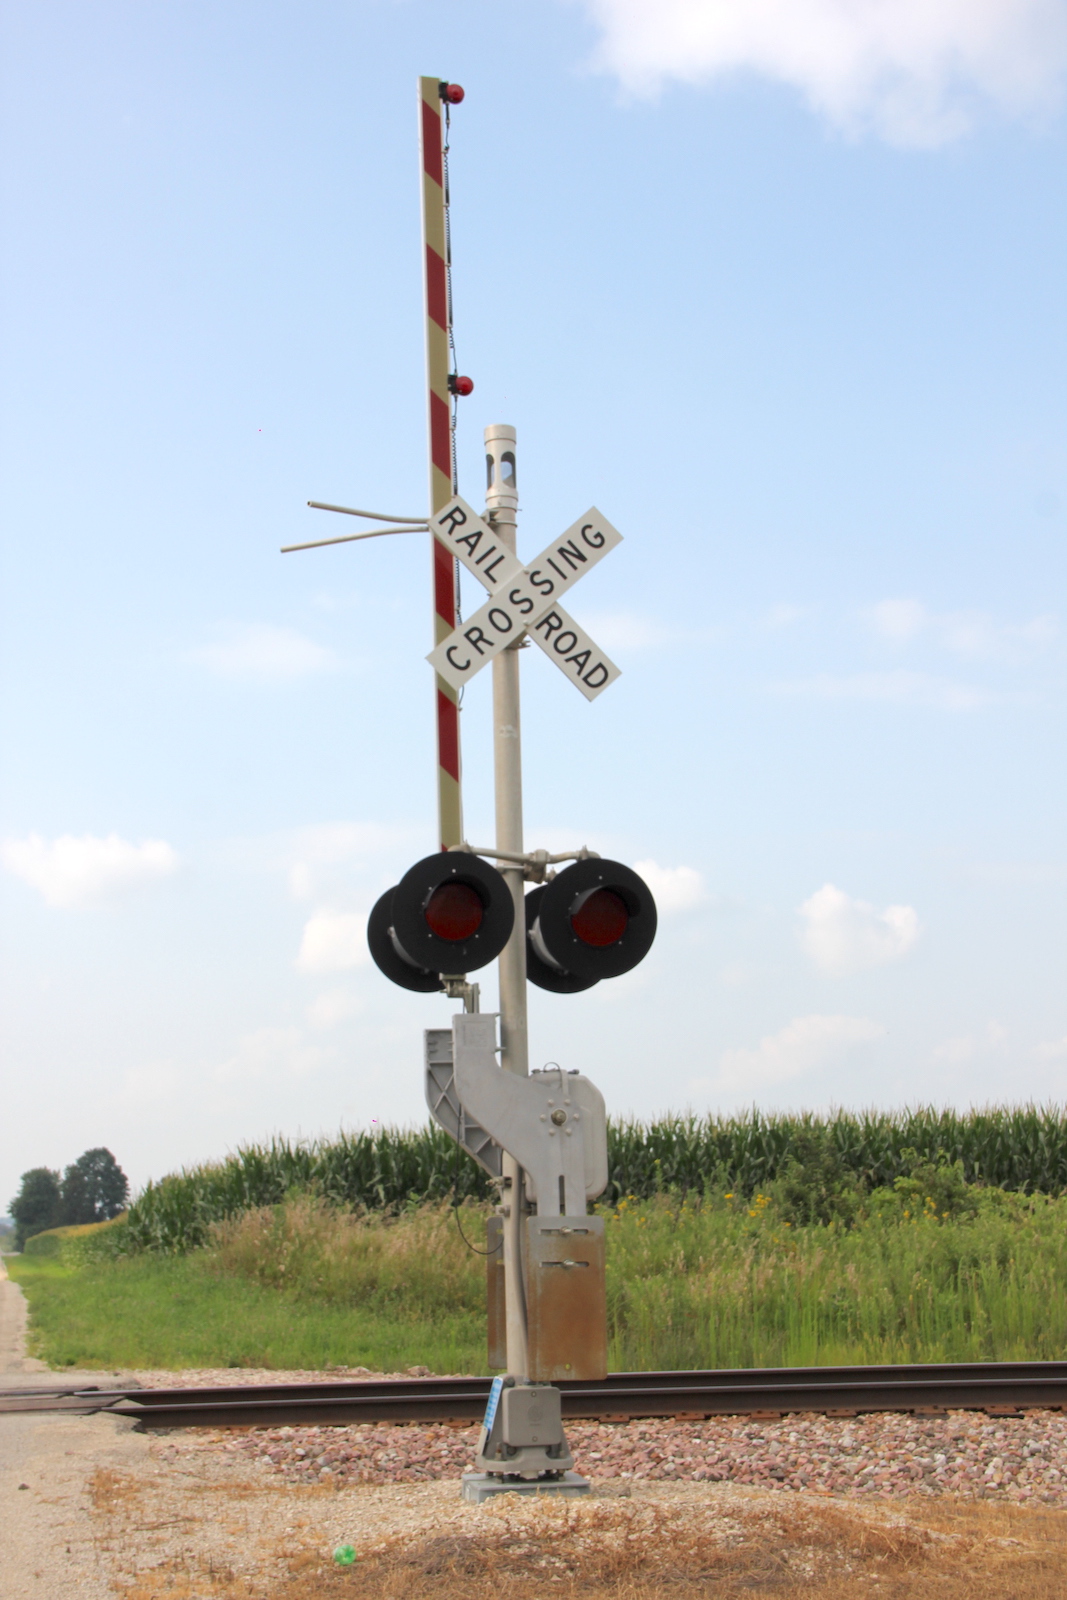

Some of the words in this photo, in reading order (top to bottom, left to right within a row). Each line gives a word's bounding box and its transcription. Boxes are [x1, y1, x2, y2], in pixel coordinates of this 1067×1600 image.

[438, 505, 505, 584] RAIL
[535, 611, 609, 689] ROAD
[446, 524, 606, 671] CROSSING
